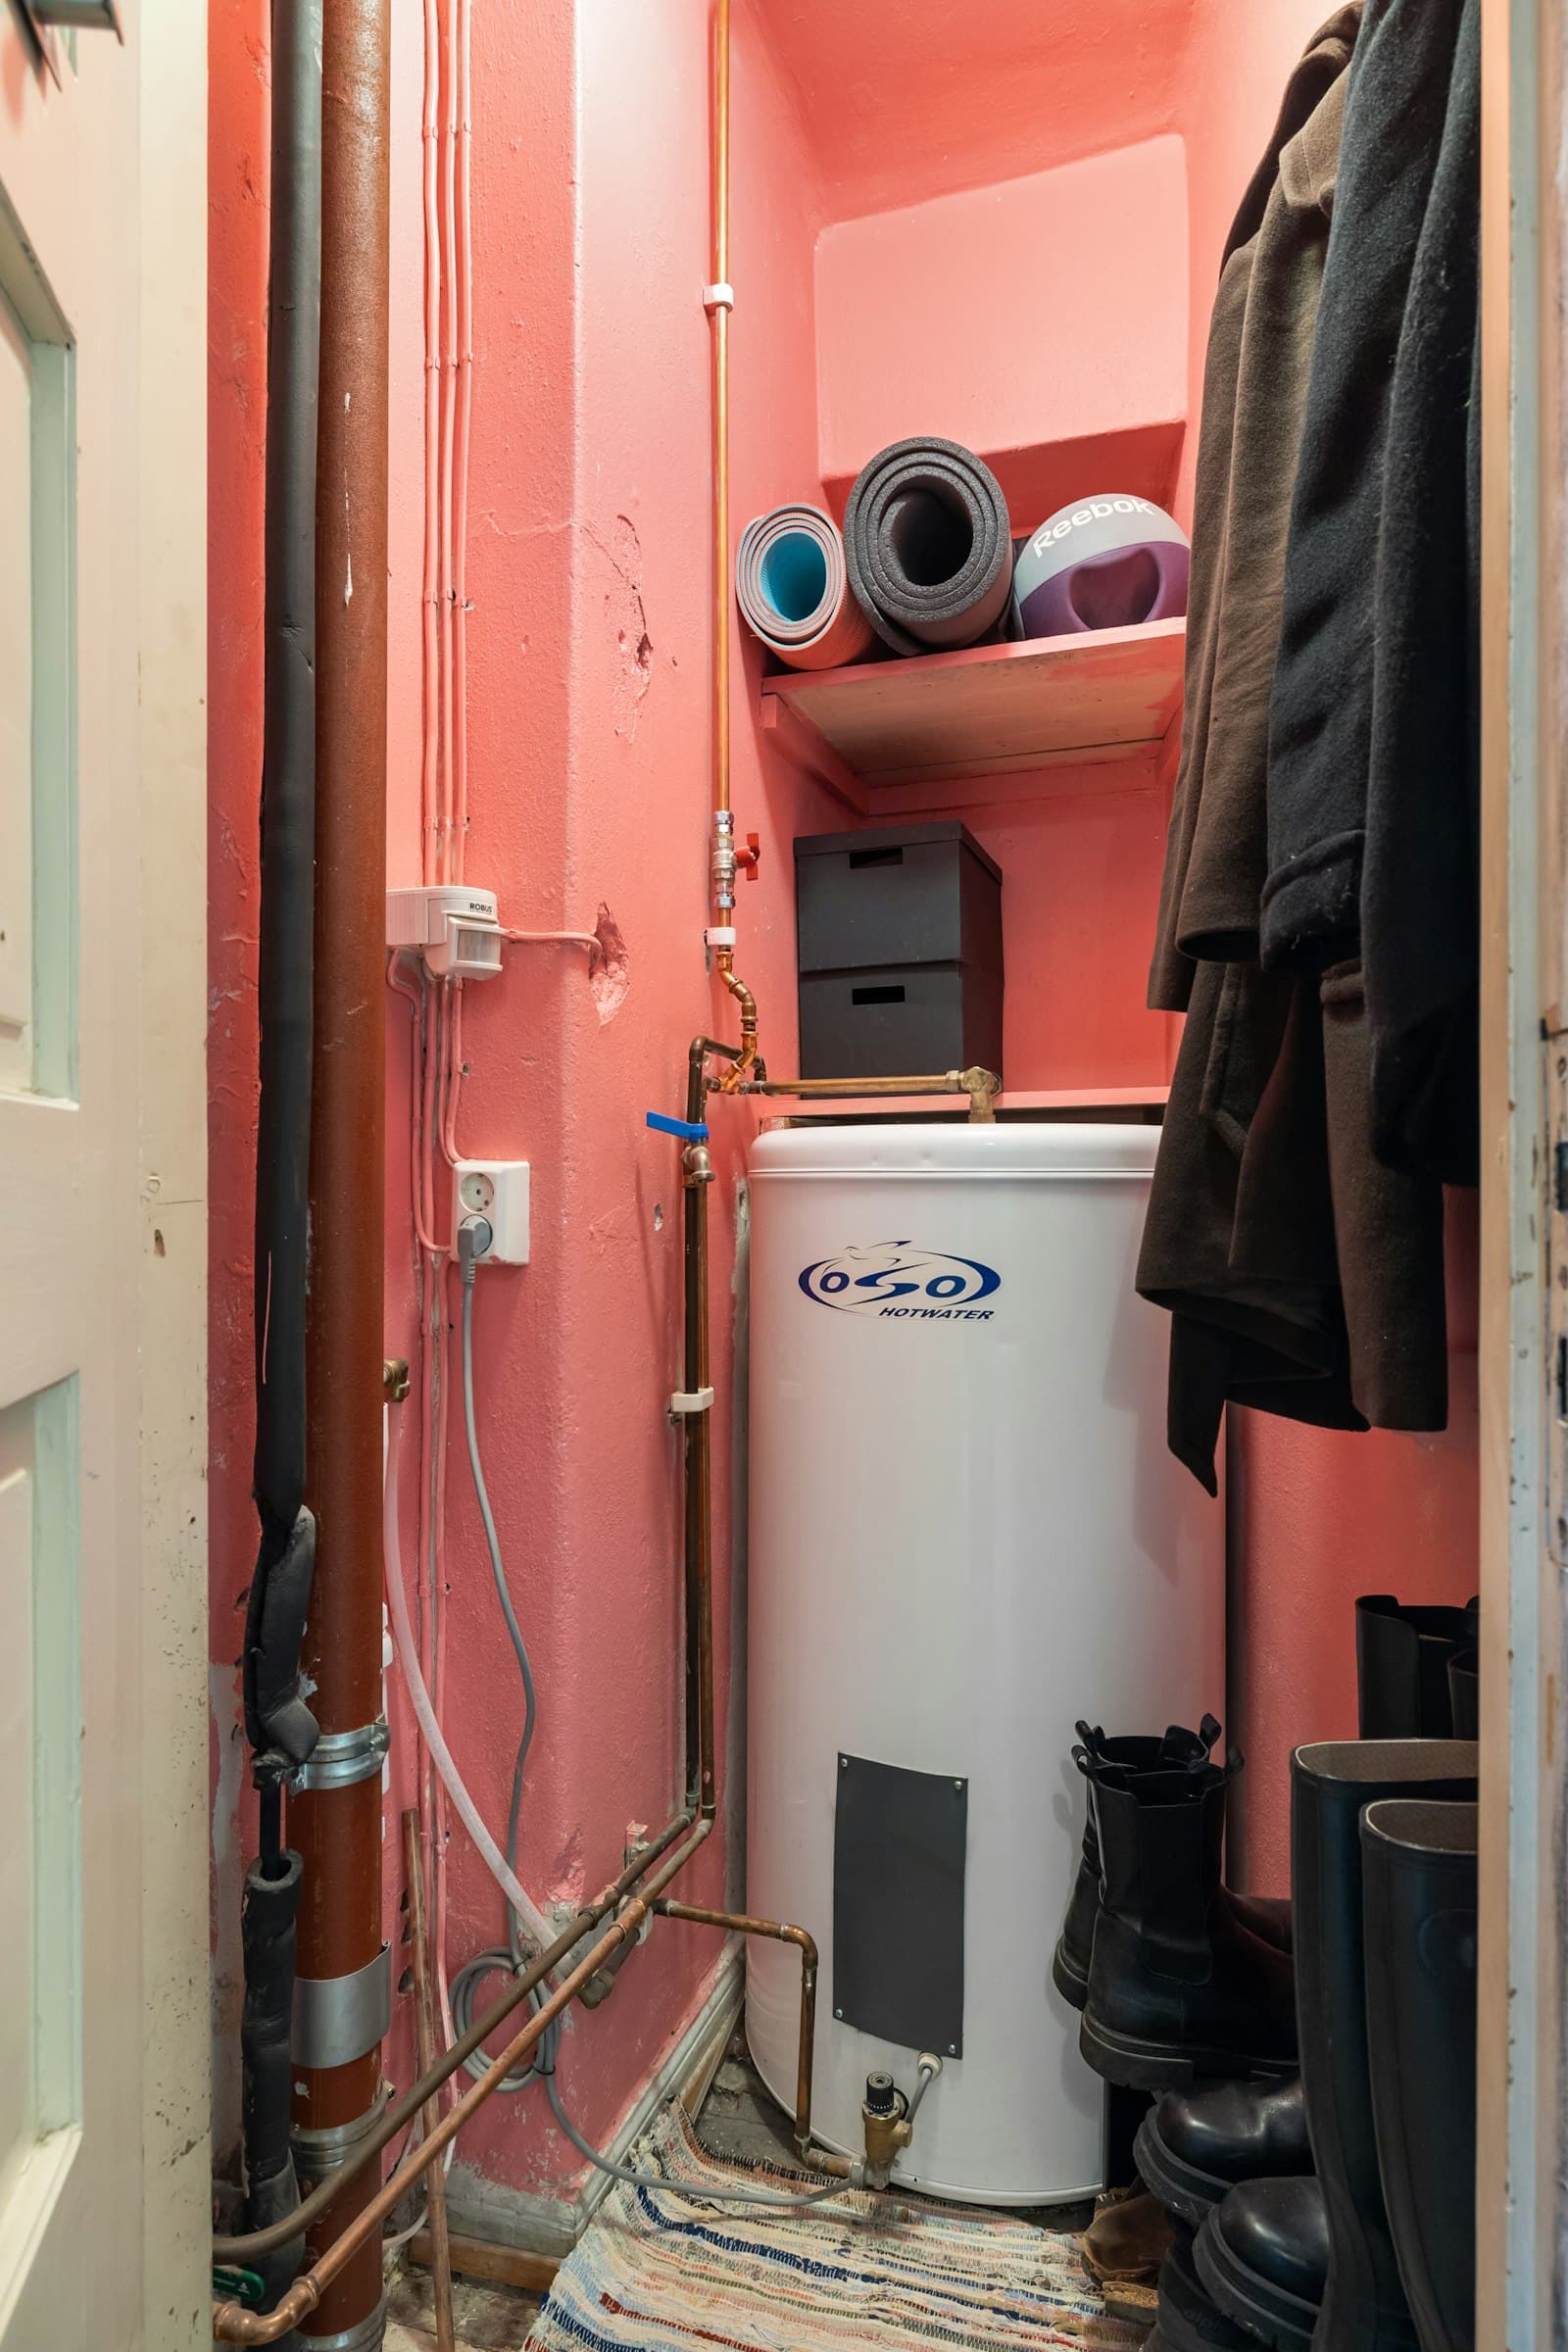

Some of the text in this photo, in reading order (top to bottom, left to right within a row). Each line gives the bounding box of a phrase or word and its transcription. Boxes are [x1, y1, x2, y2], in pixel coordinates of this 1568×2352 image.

[1032, 498, 1155, 559] Reebok
[469, 903, 493, 913] ROBUS
[818, 1262, 967, 1307] OSO
[878, 1307, 995, 1321] HOTWATER
